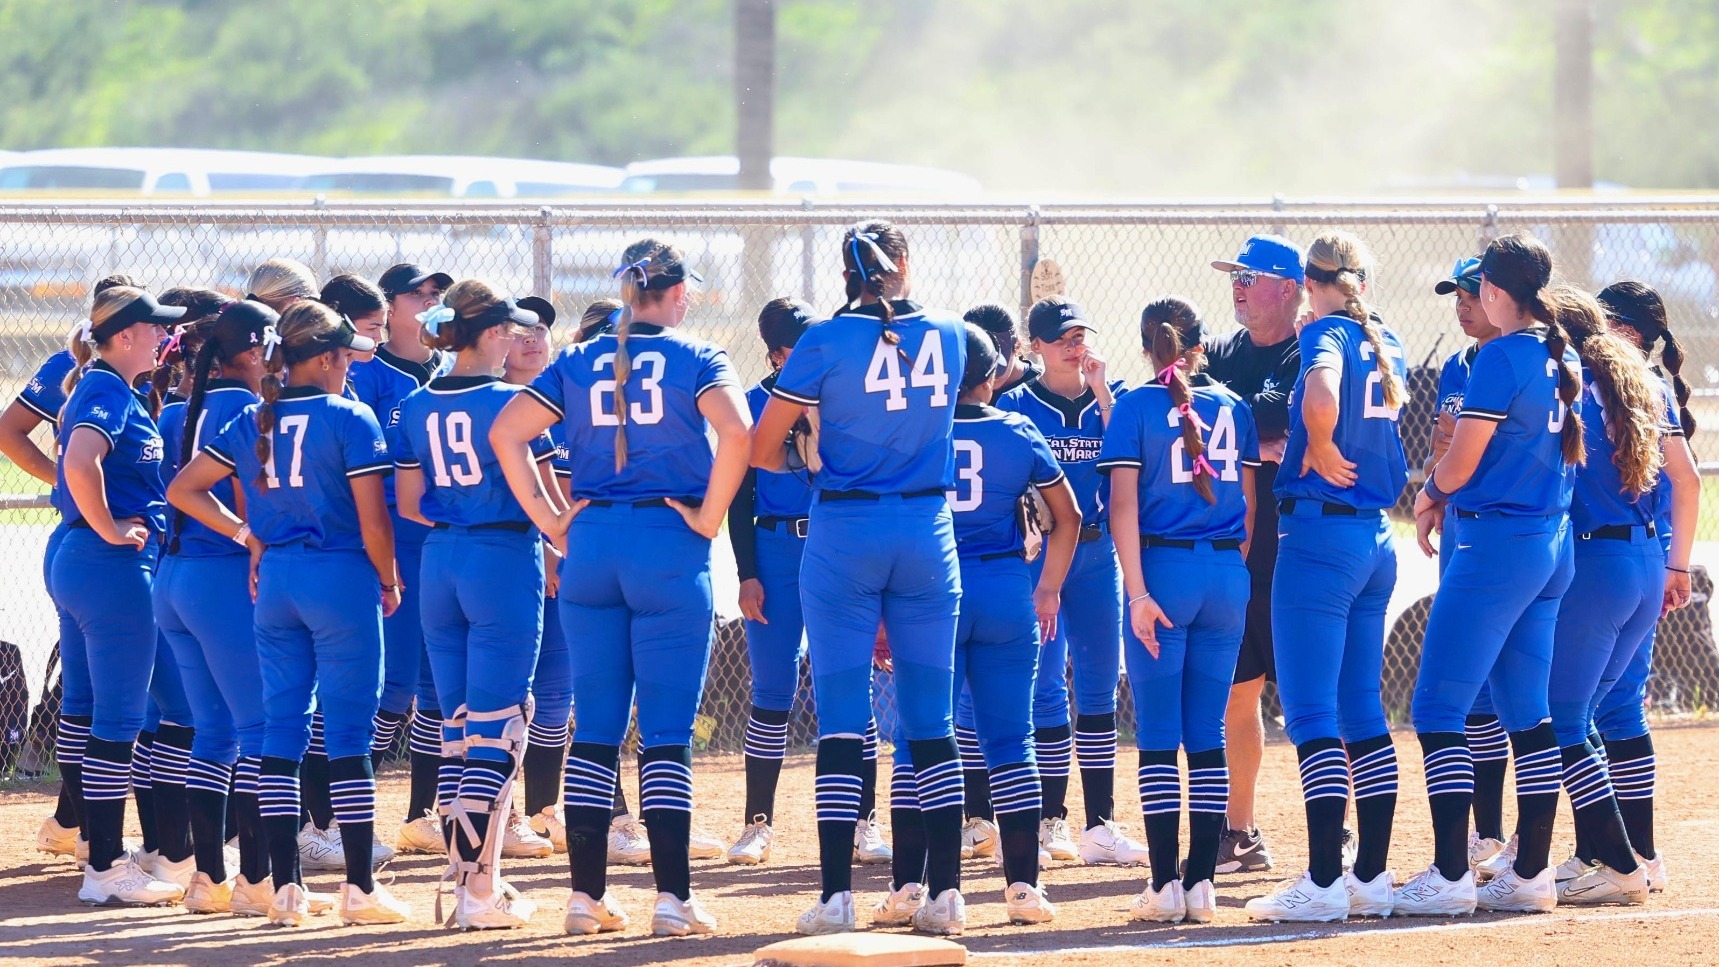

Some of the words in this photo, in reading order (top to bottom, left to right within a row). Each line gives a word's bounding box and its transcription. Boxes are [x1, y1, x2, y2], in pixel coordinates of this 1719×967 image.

[590, 351, 667, 427] 23
[864, 329, 949, 412] 44
[91, 406, 109, 419] SM
[426, 411, 483, 487] 19
[1166, 405, 1239, 484] 24
[264, 414, 310, 489] 17
[1063, 447, 1100, 461] MARC
